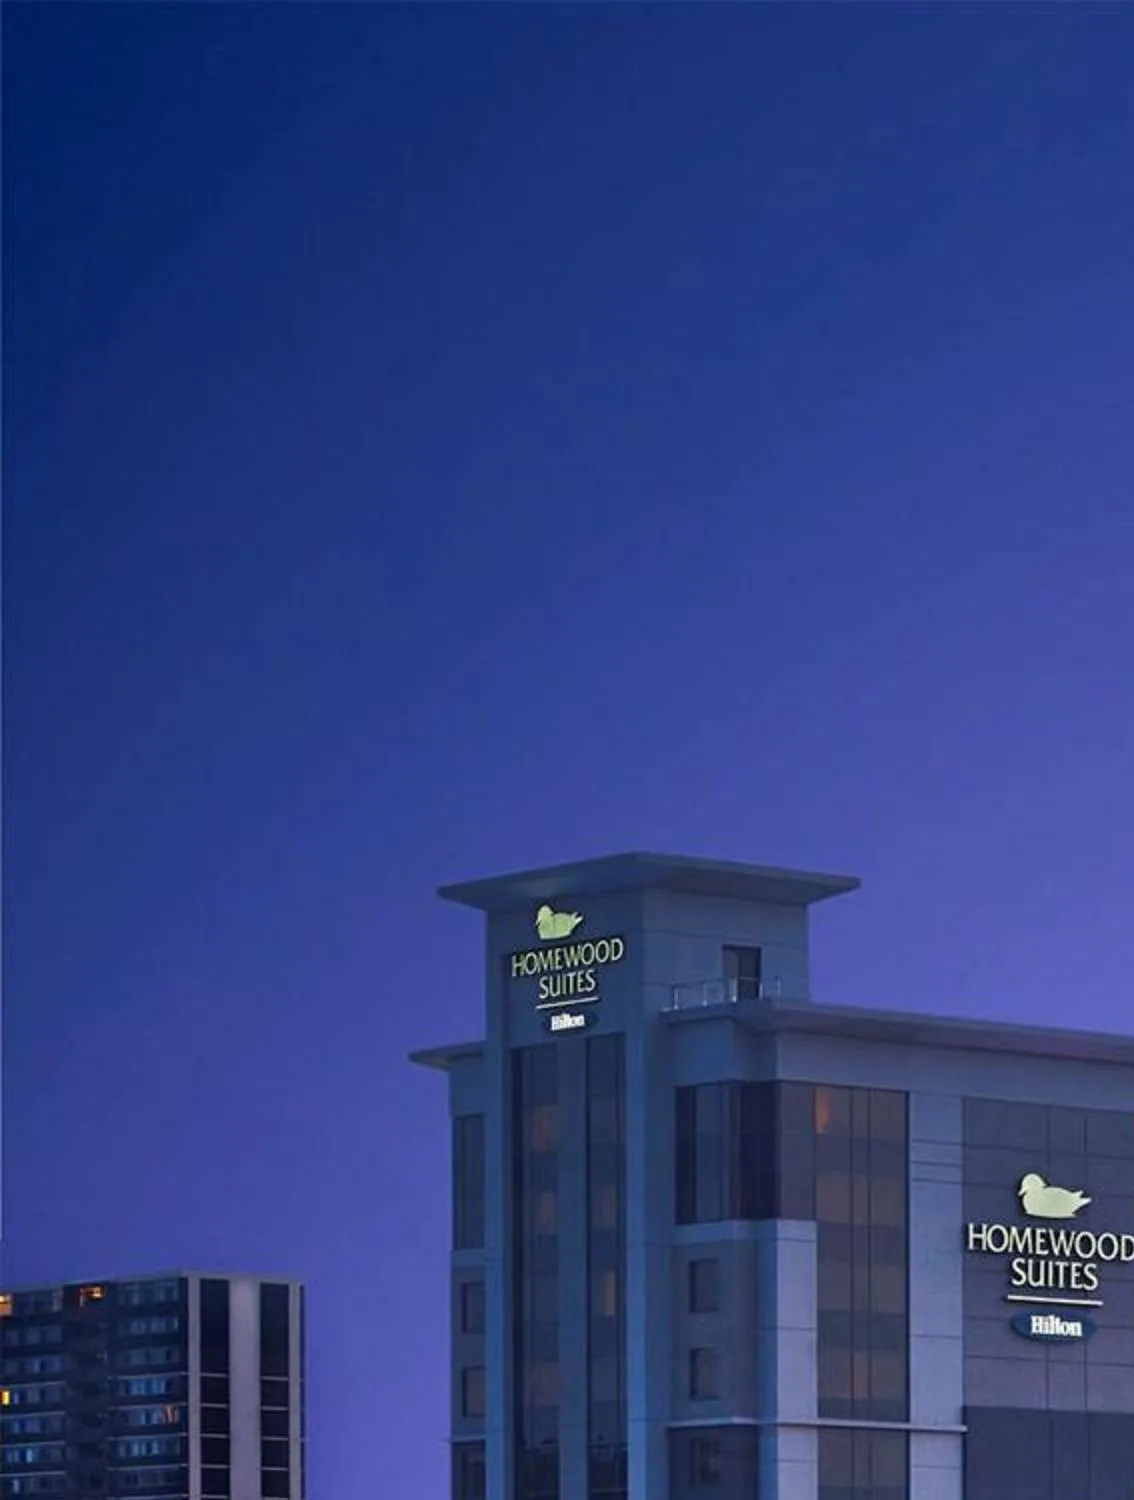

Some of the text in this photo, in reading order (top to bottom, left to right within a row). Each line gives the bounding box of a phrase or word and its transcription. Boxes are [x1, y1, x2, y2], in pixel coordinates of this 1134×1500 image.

[511, 938, 624, 977] HOMEWOOD
[539, 969, 597, 999] SUITES
[551, 1013, 586, 1031] Hilton
[1010, 1257, 1099, 1291] SUITES
[1030, 1315, 1084, 1337] Hilton
